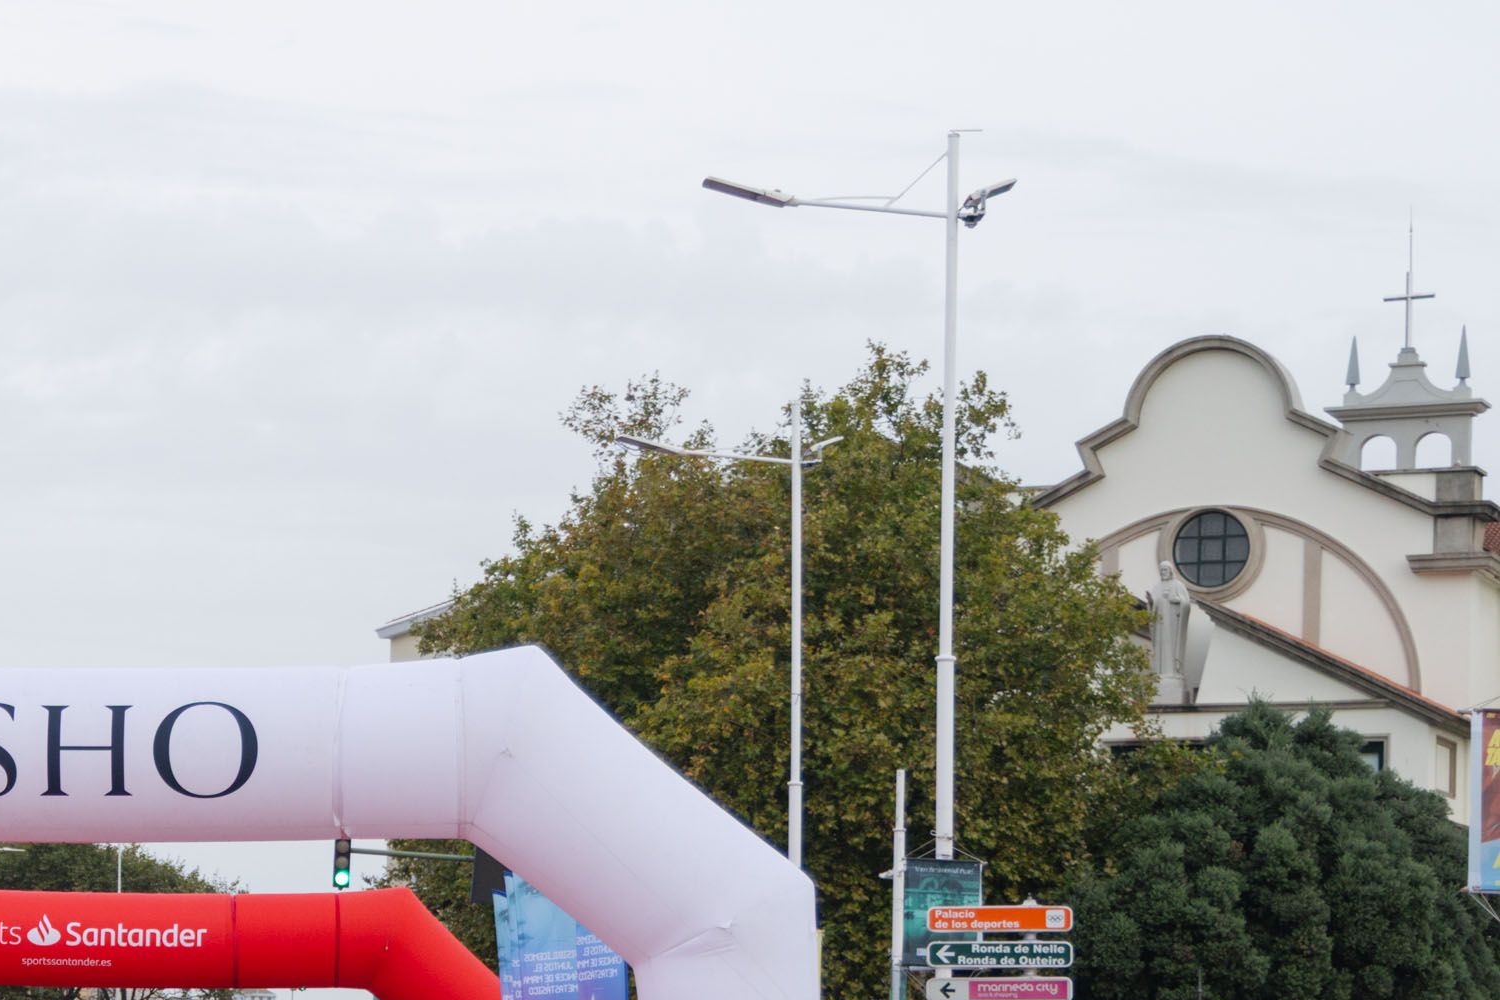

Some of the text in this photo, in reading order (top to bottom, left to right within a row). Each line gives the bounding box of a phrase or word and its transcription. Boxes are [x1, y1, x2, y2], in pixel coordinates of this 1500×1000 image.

[935, 909, 975, 919] Palacio
[935, 920, 1020, 930] de los deportes
[65, 921, 208, 948] Santander
[971, 944, 1065, 953] Ronda de Nelle
[21, 956, 112, 968] sportssantander.es
[958, 956, 1065, 965] Ronda de Outeiro
[978, 983, 1059, 995] marineda city
